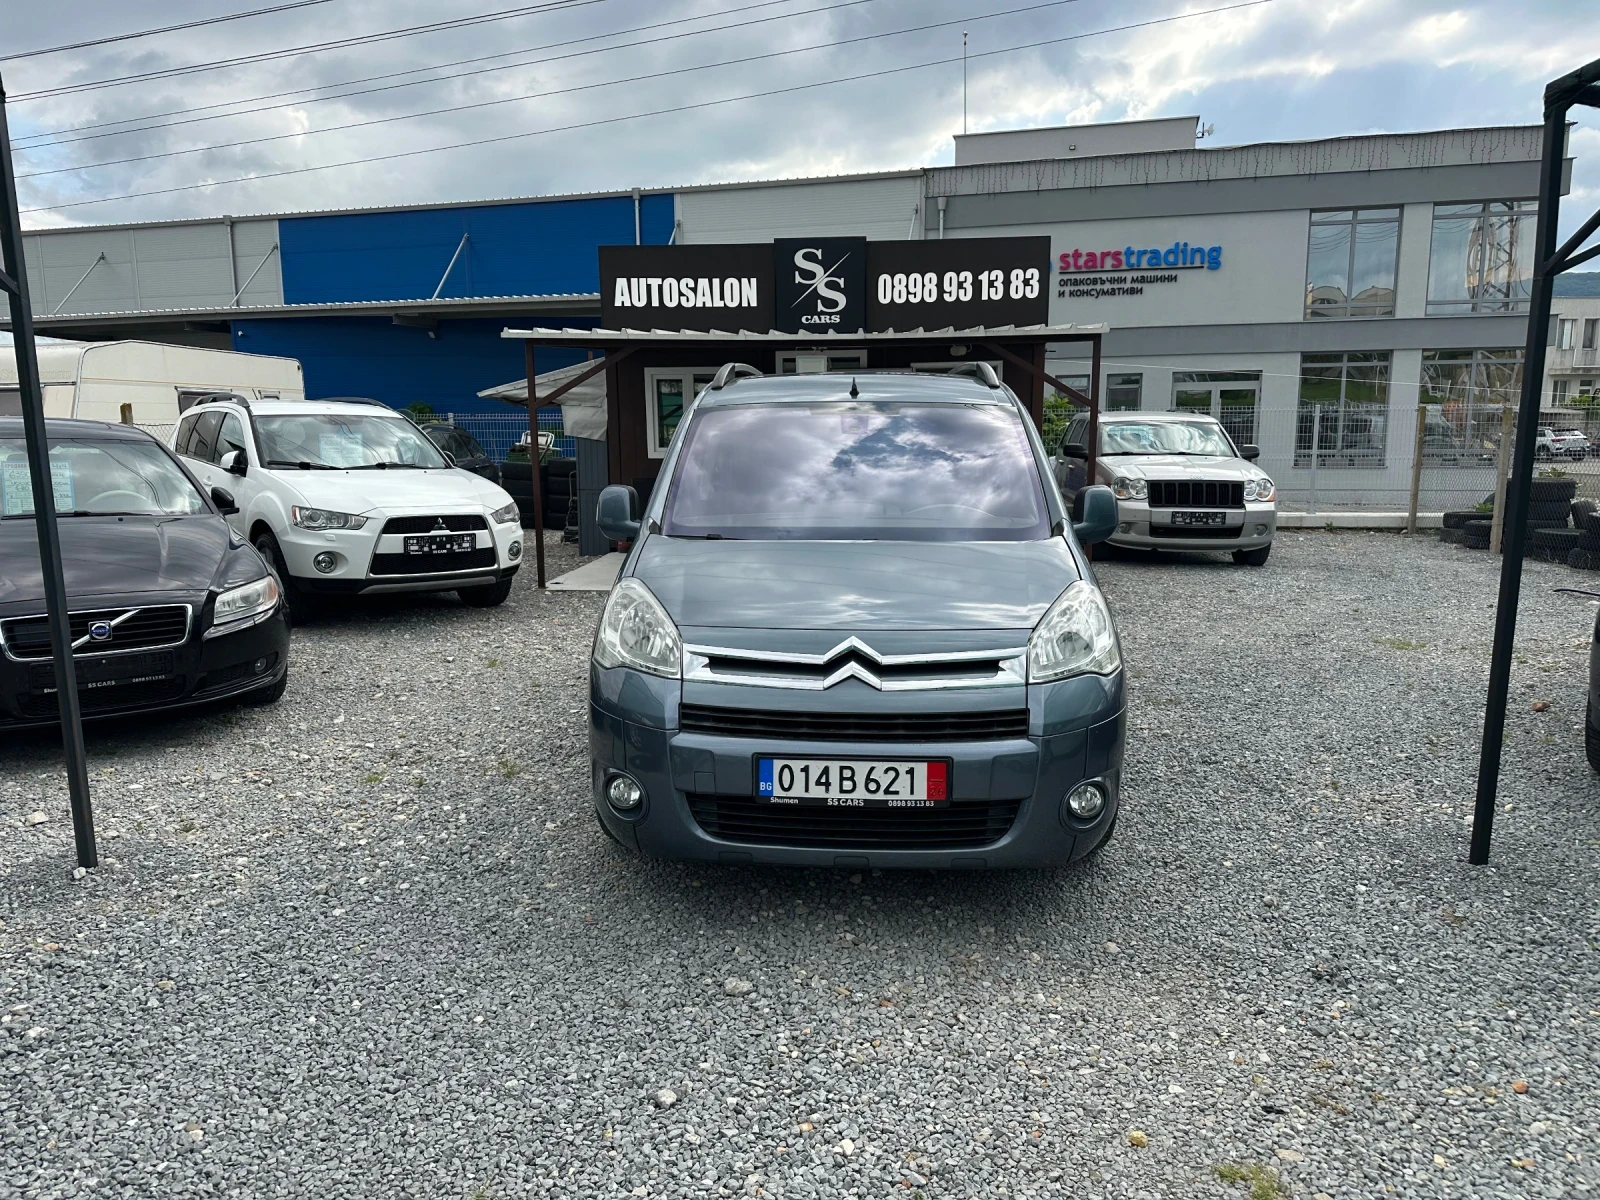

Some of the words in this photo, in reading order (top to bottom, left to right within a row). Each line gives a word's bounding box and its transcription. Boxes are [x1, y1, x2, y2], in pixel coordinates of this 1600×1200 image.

[1059, 242, 1222, 270] starstrading
[1058, 275, 1127, 287] опаковъчни
[1131, 273, 1178, 285] машини
[877, 273, 938, 305] 0898
[943, 271, 973, 302] 93
[977, 269, 1004, 301] 13
[1009, 268, 1040, 299] 83
[614, 277, 758, 308] AUTOSALON
[1058, 289, 1065, 298] и
[1069, 286, 1143, 299] консумативи
[801, 314, 841, 324] CARS
[97, 680, 115, 688] CARS
[760, 782, 772, 791] BG
[770, 796, 799, 805] Shumen
[827, 798, 838, 806] SS
[840, 798, 864, 807] CARS
